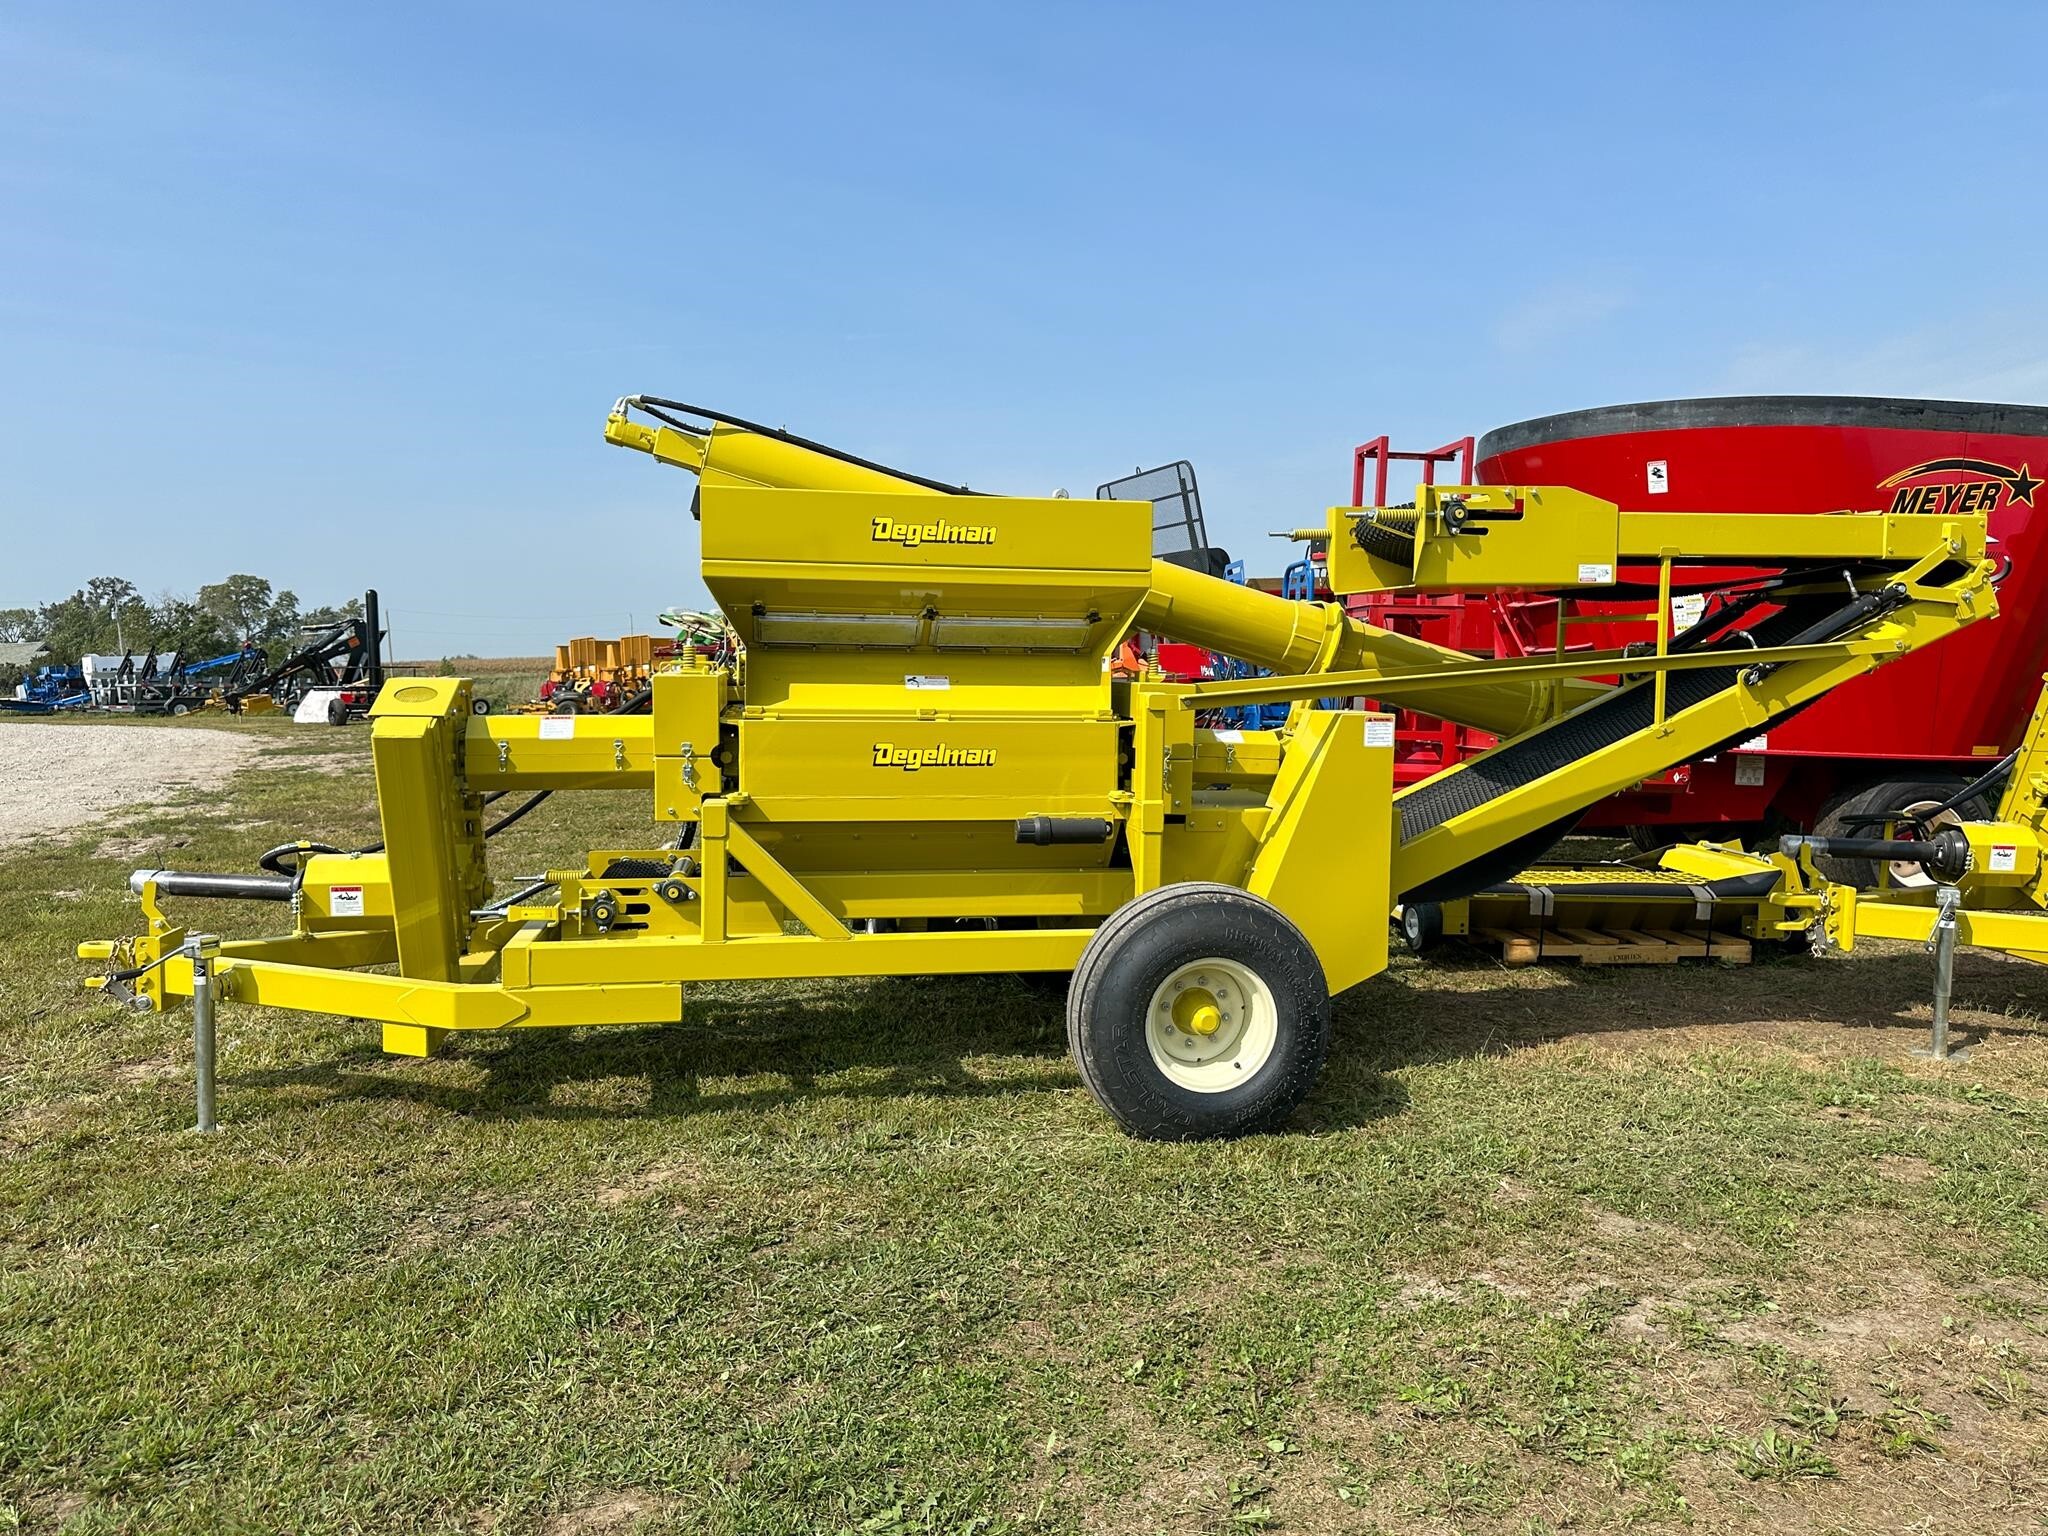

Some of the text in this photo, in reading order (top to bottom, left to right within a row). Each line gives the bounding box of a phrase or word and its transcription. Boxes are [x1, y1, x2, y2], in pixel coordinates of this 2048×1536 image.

[1890, 481, 2004, 515] MEYER
[872, 517, 997, 547] Degelman
[873, 742, 997, 771] Degelman
[1111, 1023, 1193, 1127] CARLSTAR
